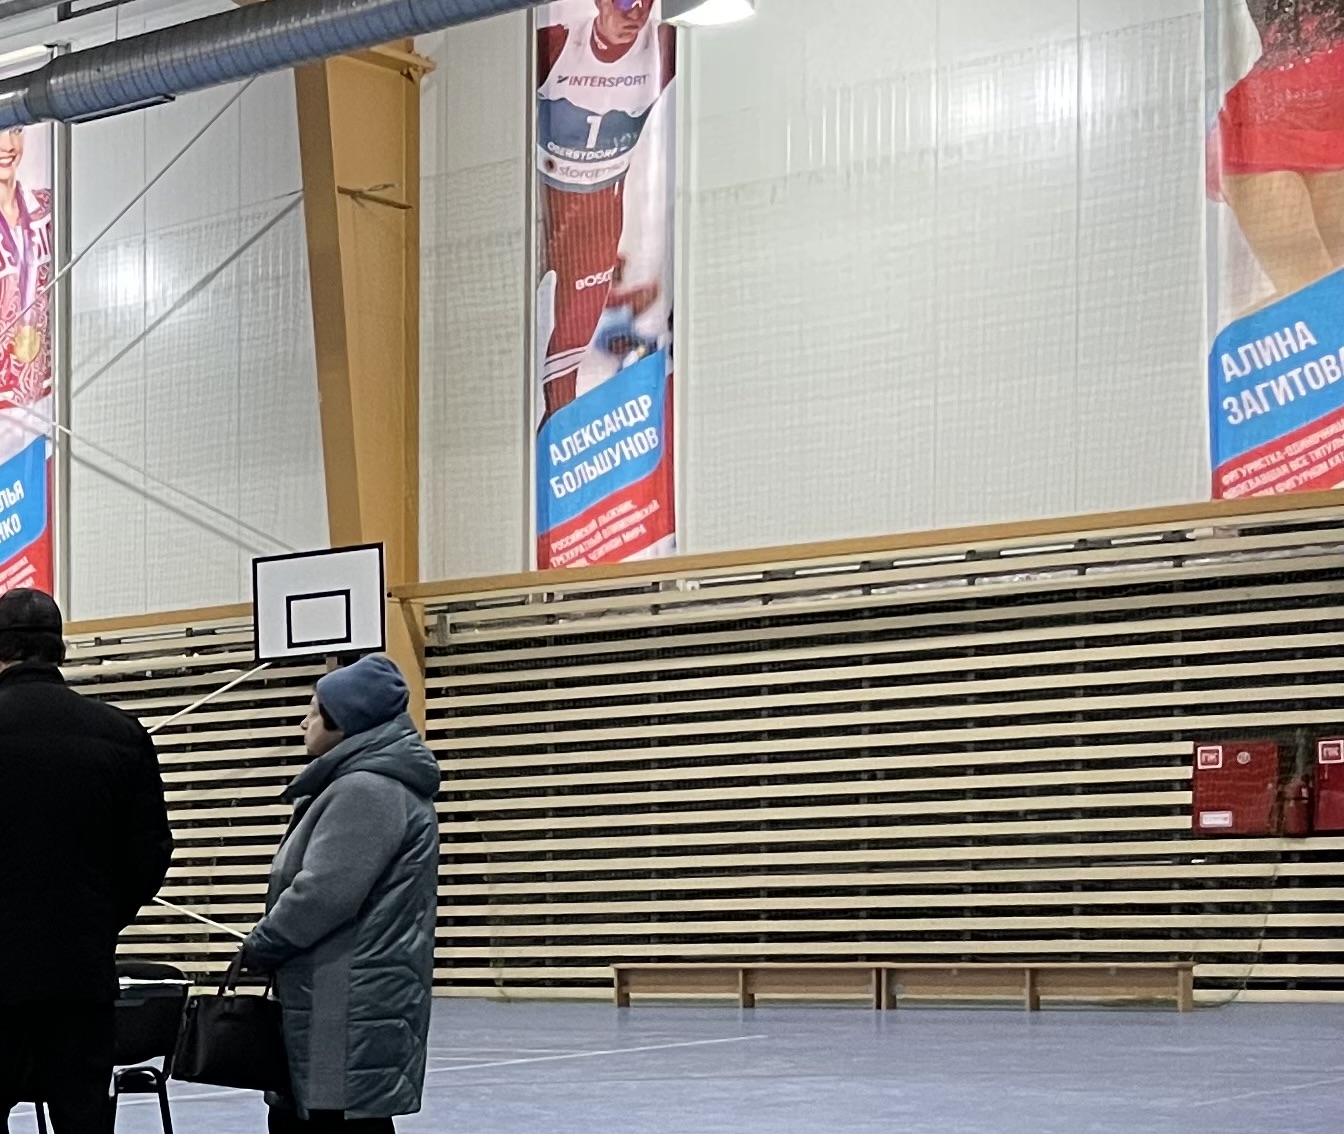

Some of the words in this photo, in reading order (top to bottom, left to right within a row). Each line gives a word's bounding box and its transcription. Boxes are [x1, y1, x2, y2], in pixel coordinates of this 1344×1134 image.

[568, 74, 648, 87] INTERSPORT
[586, 115, 602, 148] 1
[1220, 320, 1318, 383] АЛИНА
[549, 394, 652, 466] АЛЕКСАНДР
[549, 426, 660, 499] БОЛЬШУНОВ
